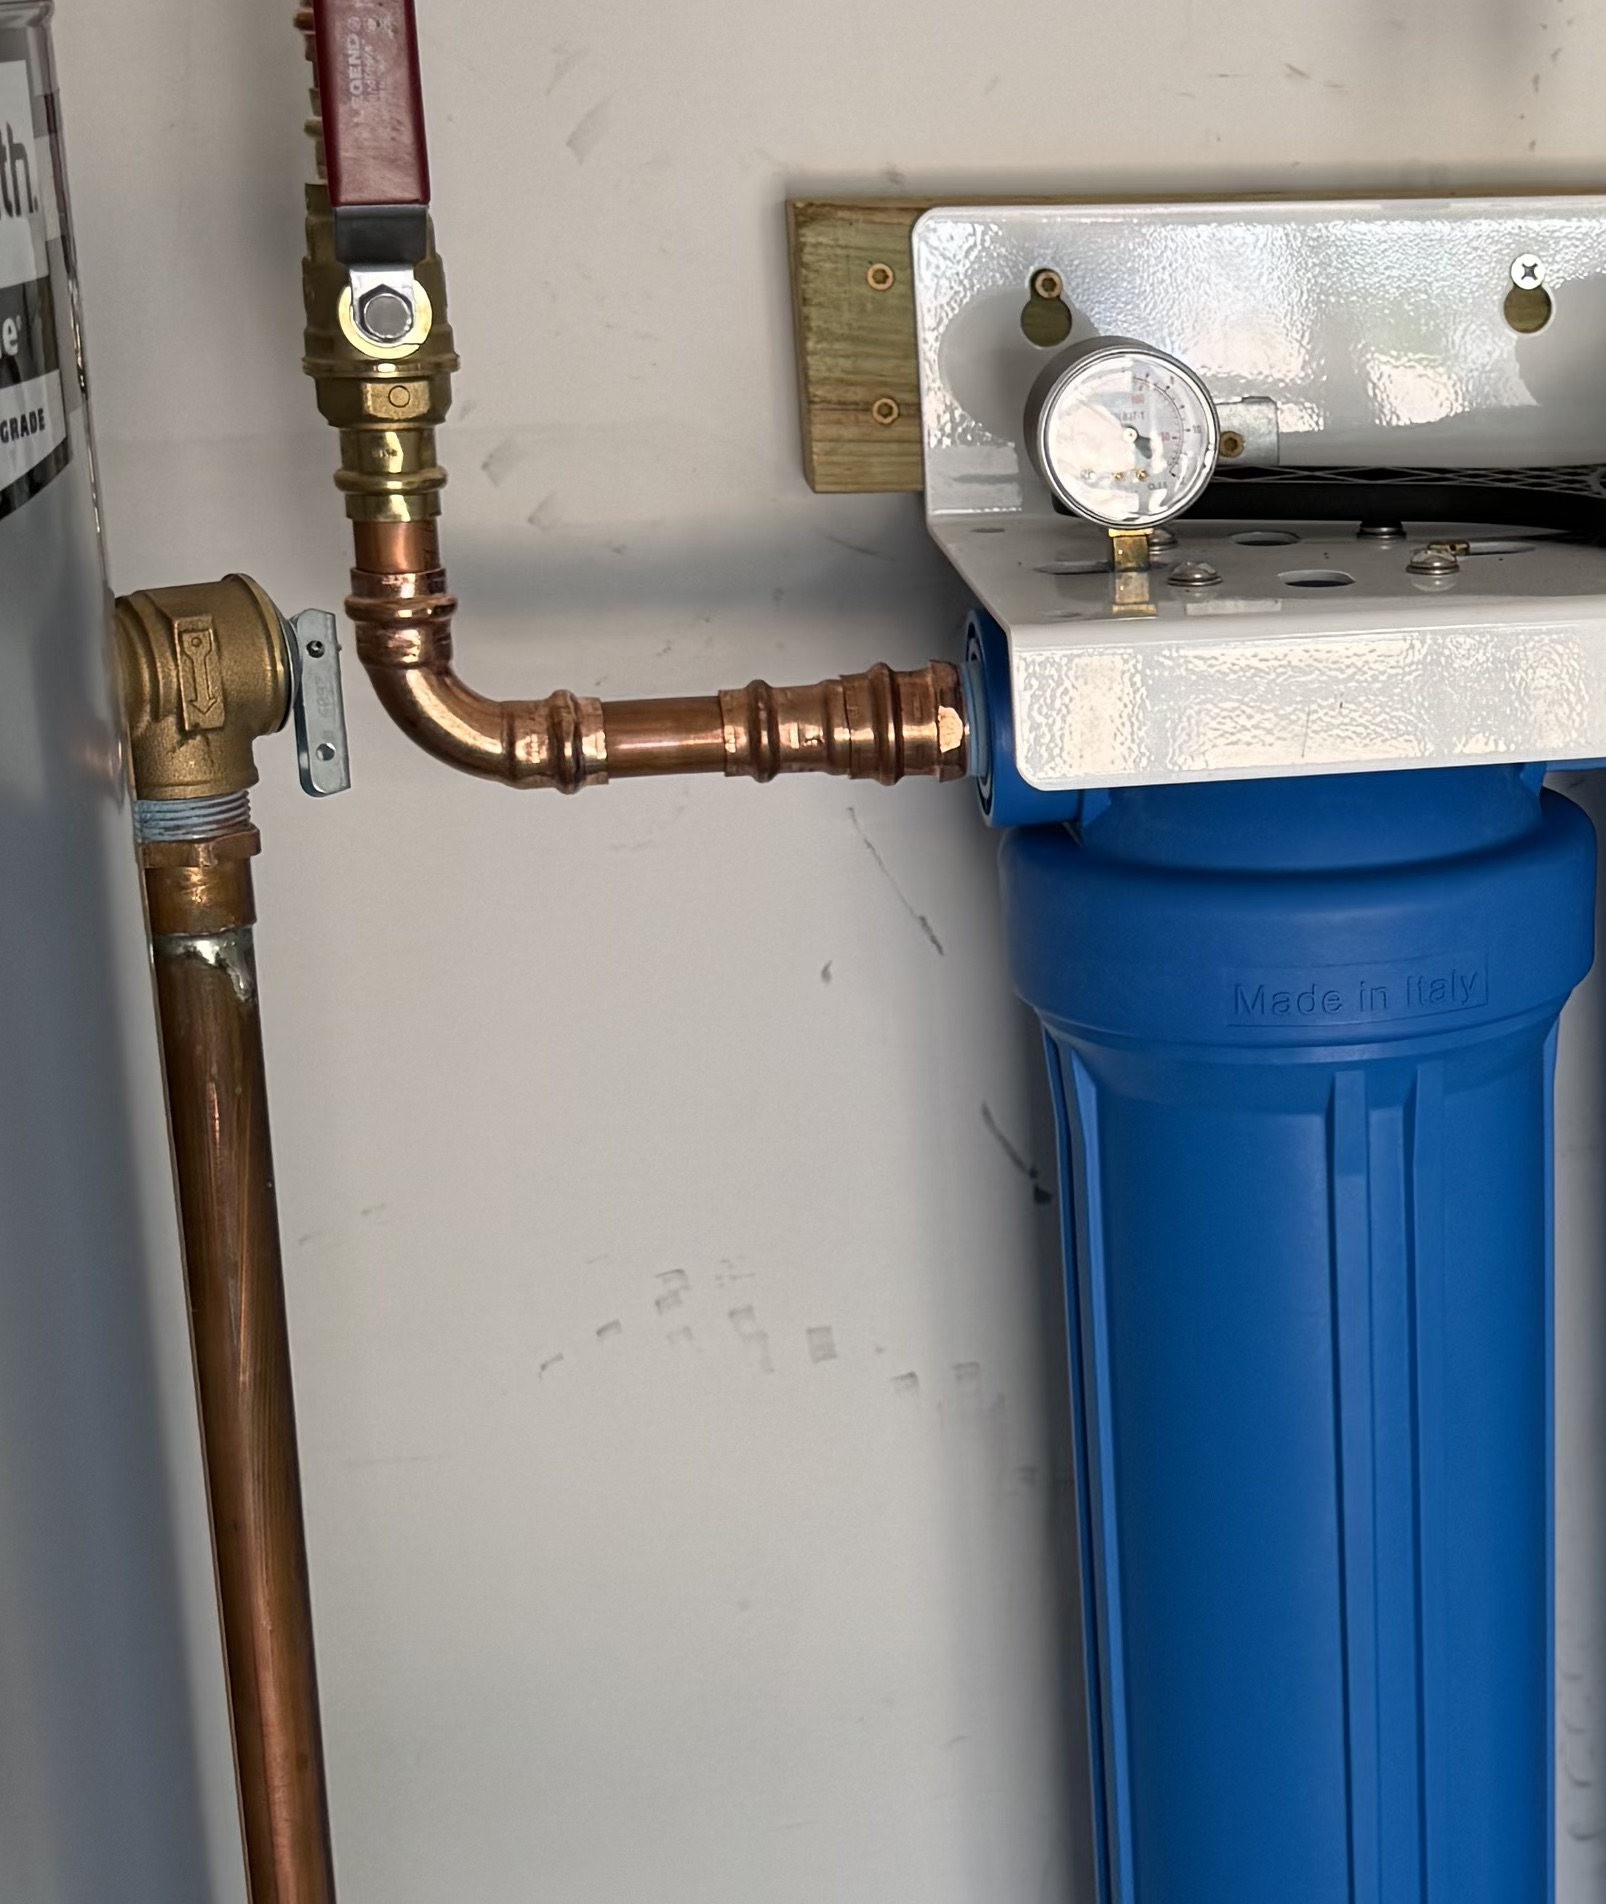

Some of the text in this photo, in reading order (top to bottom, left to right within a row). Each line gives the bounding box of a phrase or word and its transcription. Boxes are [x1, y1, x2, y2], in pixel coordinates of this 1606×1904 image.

[0, 408, 45, 443] GRADE
[1233, 969, 1478, 1016] Made in Italy
